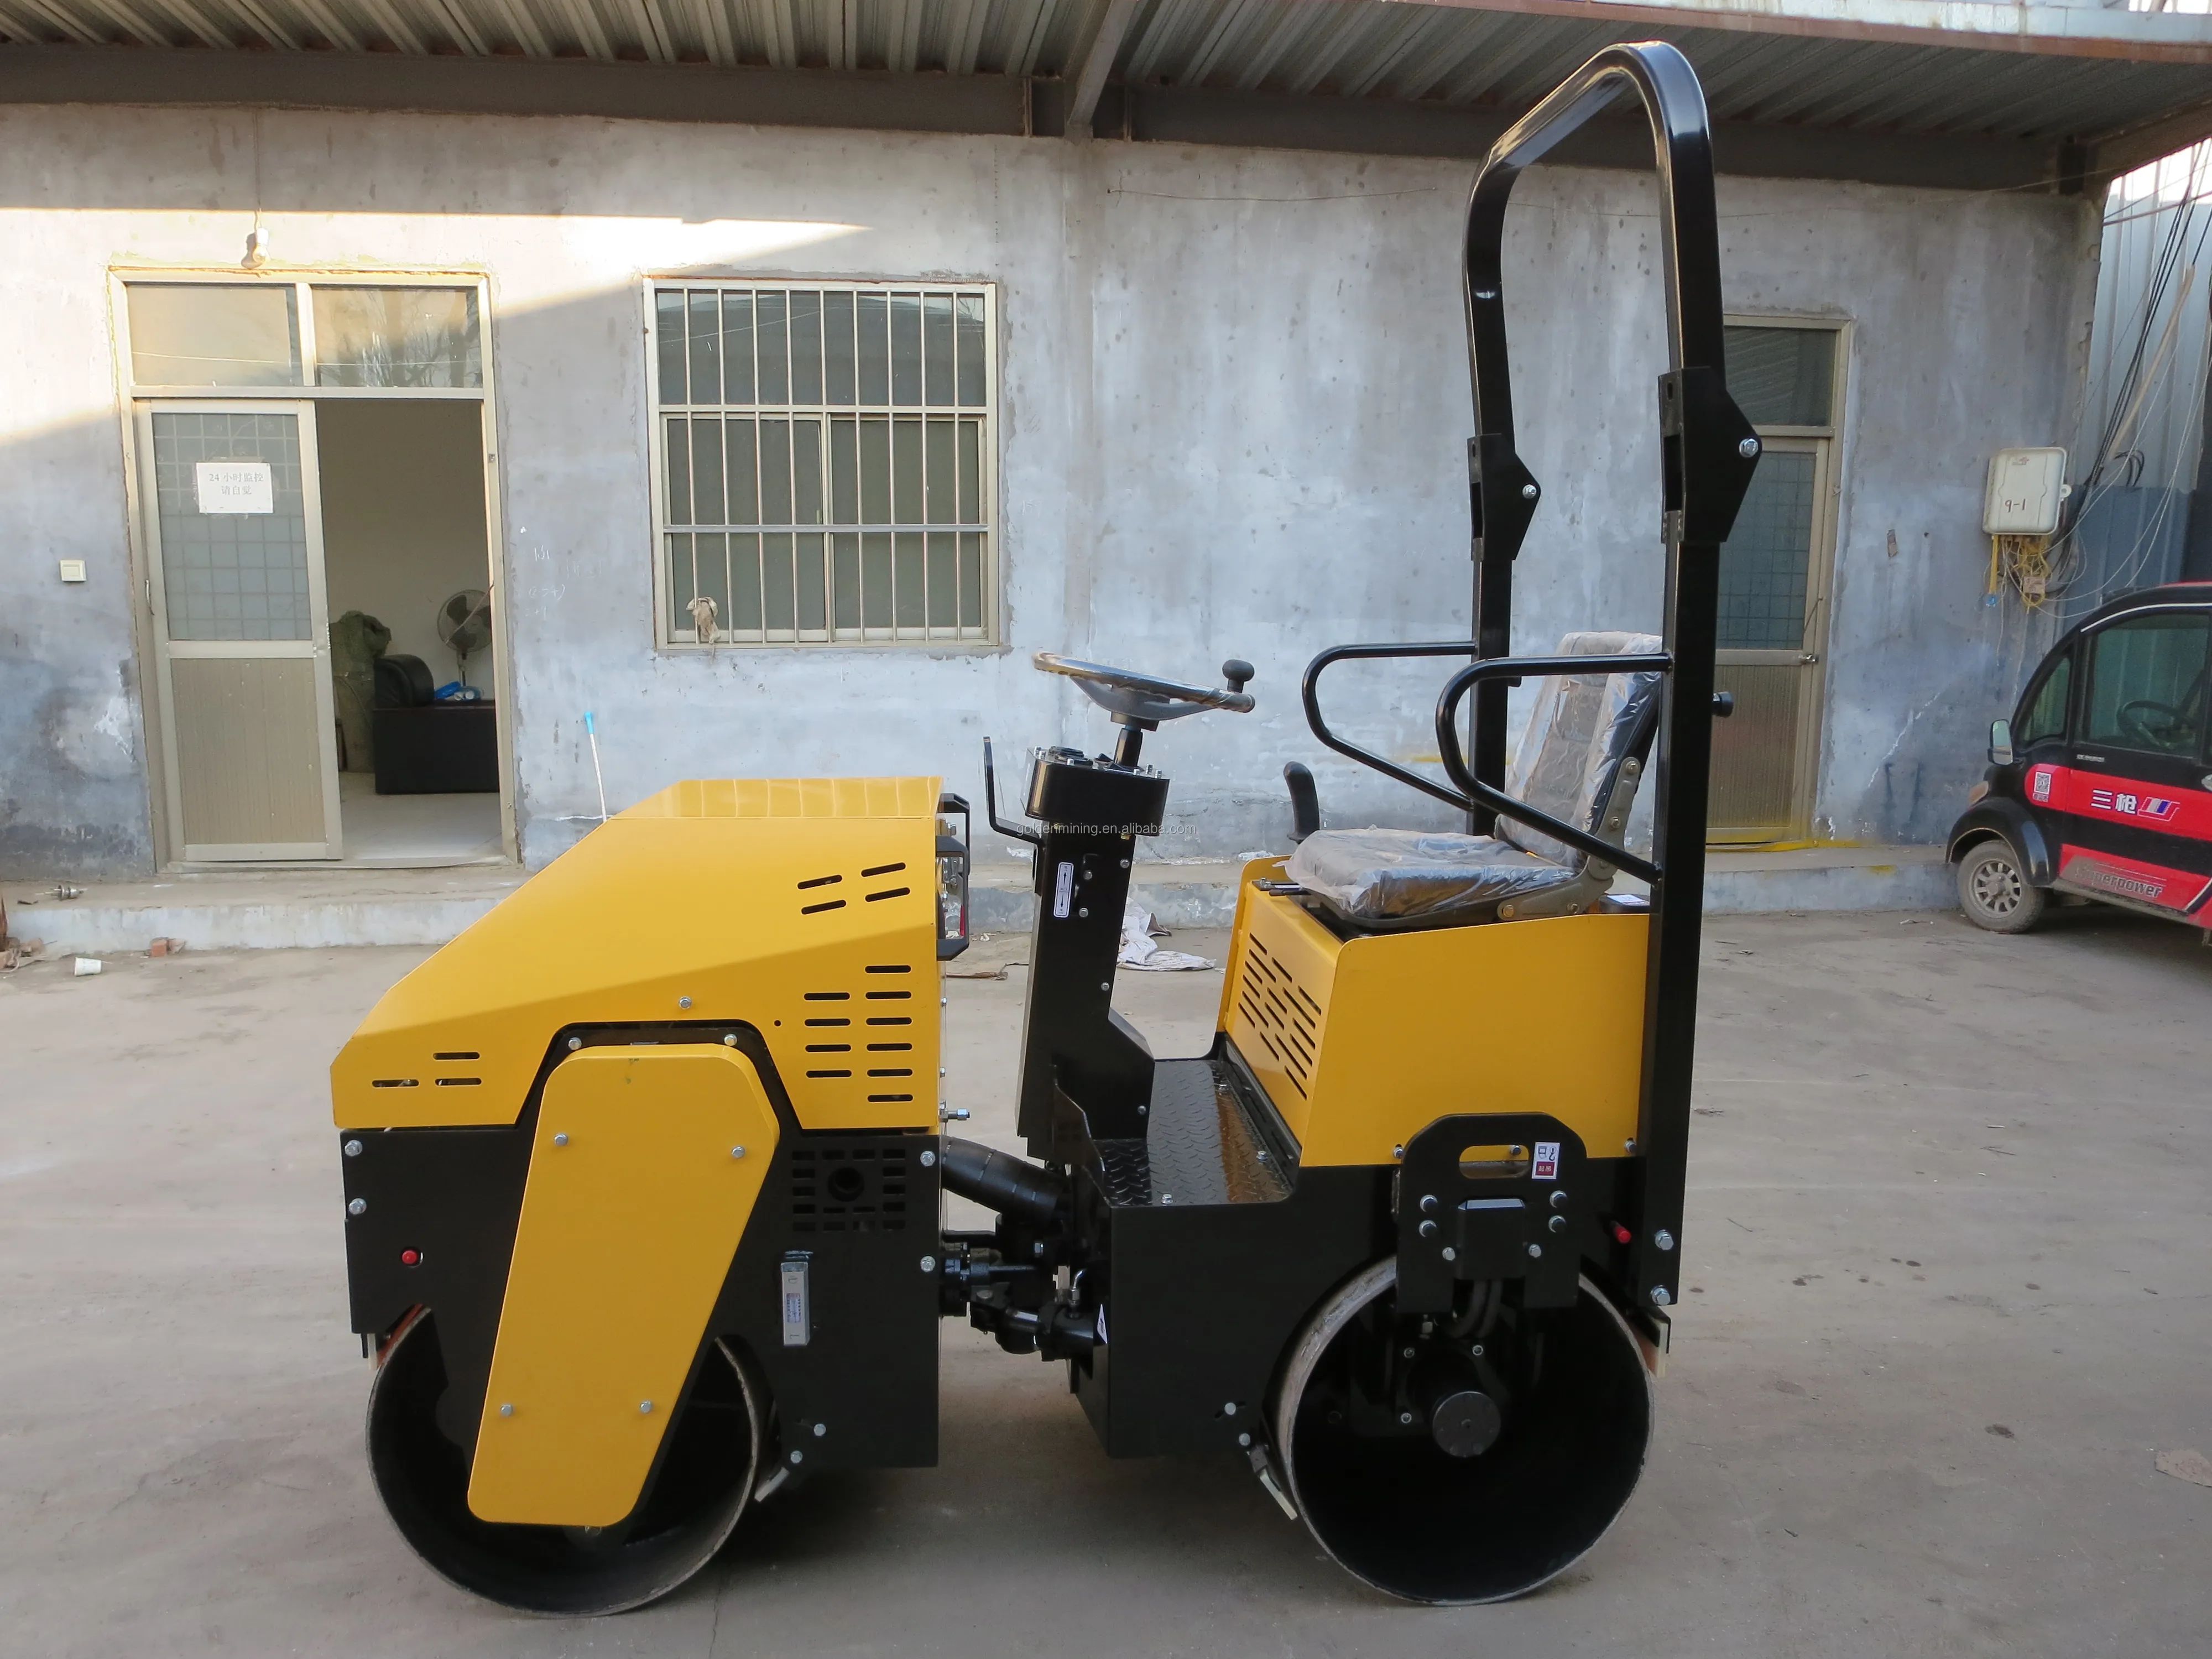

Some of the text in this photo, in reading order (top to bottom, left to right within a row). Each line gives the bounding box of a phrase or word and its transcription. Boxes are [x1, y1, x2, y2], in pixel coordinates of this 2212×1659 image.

[208, 472, 264, 482] 24 小时监控
[221, 485, 252, 495] 请自觉
[2005, 498, 2026, 513] 9-1
[2091, 789, 2137, 815] 三枪
[2075, 864, 2163, 898] perpower
